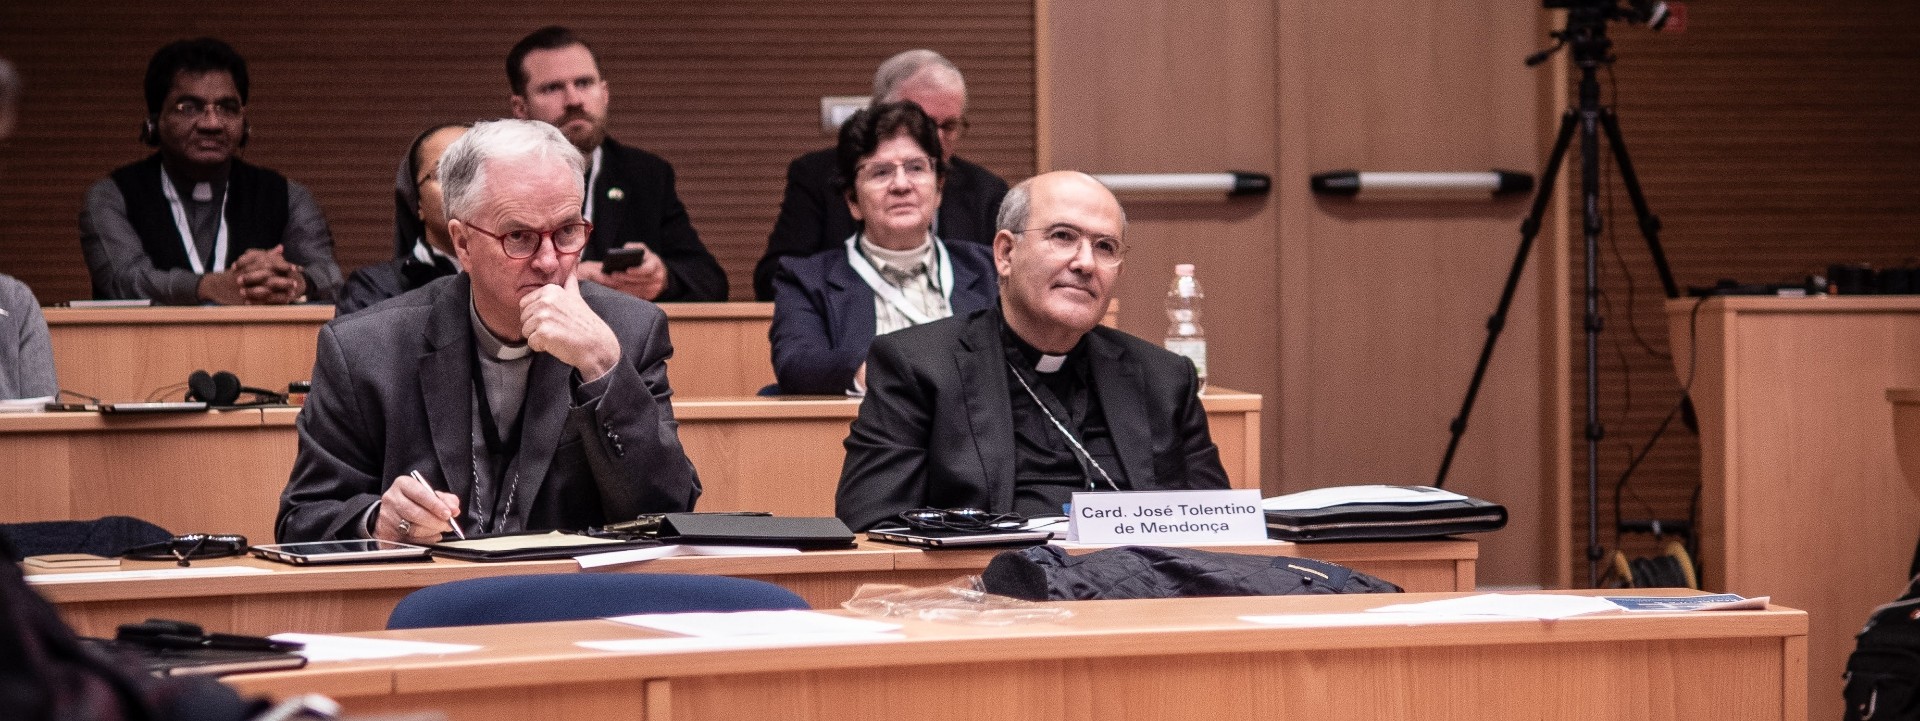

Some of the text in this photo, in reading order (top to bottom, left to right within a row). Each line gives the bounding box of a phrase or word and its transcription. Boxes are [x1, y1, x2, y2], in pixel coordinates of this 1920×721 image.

[1082, 503, 1256, 519] Card. José Tolentino
[1114, 521, 1230, 534] de Mendonça
